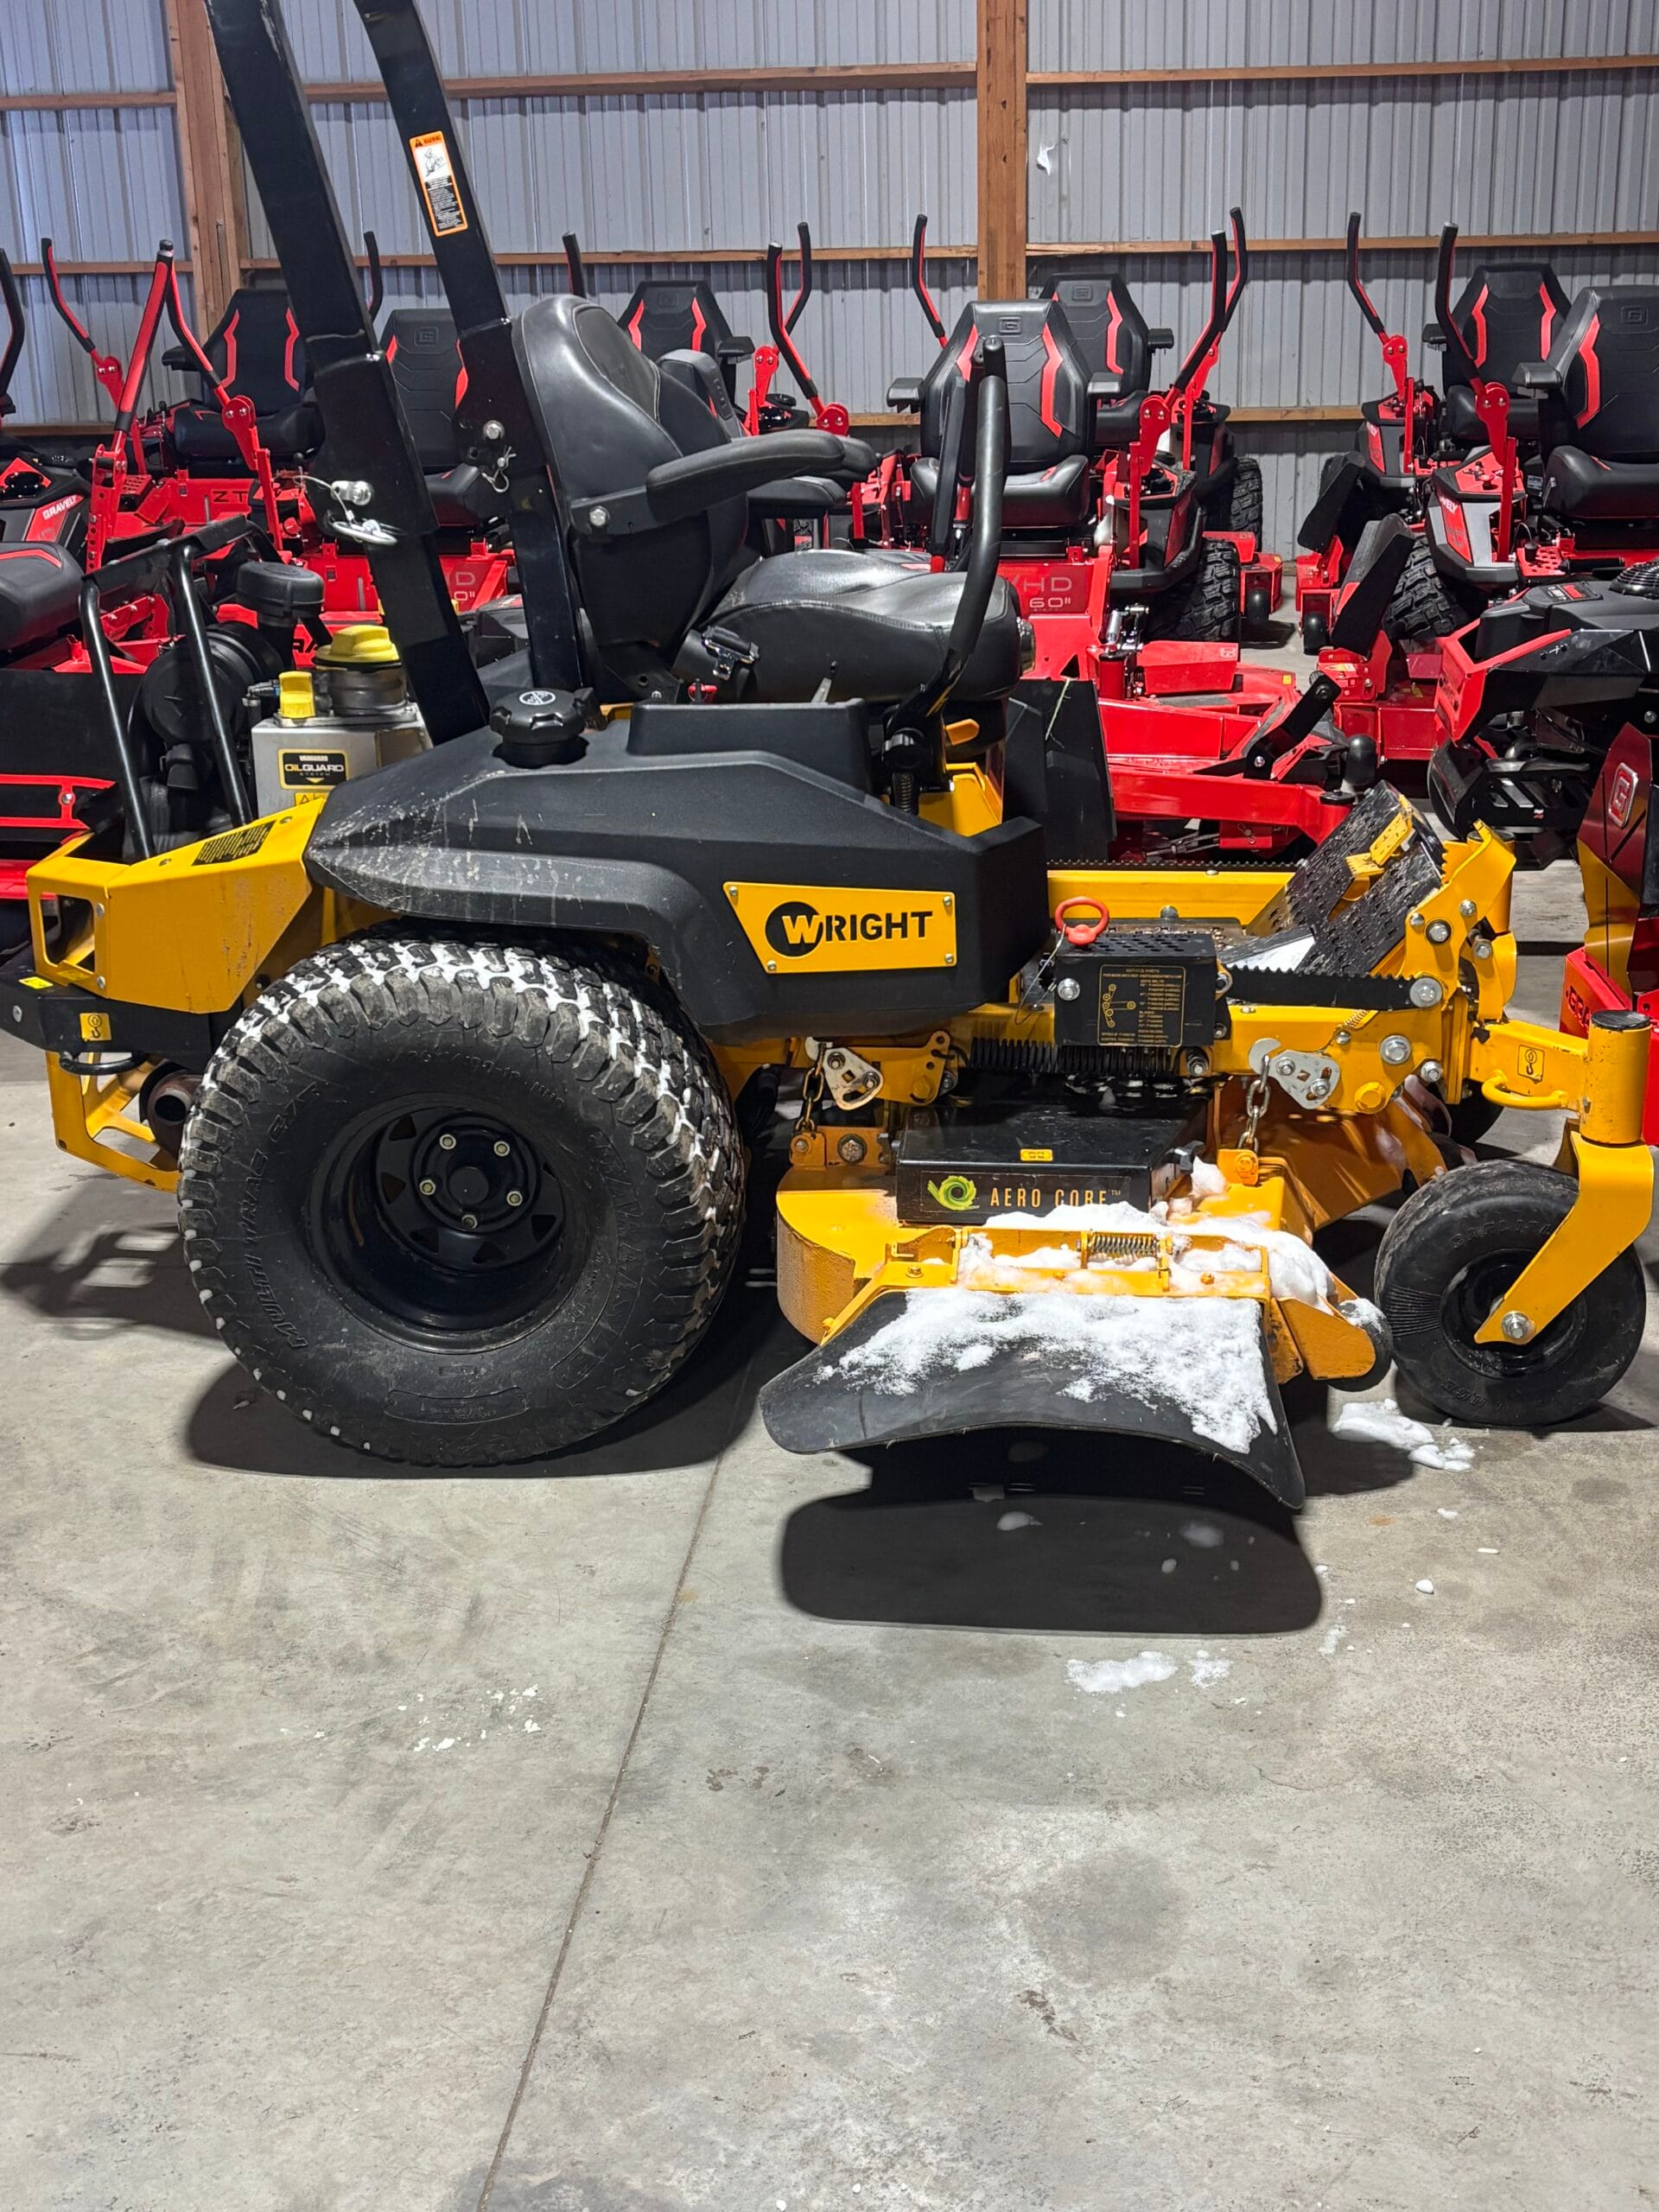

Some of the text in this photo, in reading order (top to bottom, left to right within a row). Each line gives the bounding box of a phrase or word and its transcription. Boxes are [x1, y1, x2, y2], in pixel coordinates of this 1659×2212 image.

[41, 494, 78, 518] GRAVELY
[1029, 596, 1071, 608] 60"
[781, 910, 933, 945] WRIGHT
[989, 1187, 1042, 1208] AERO
